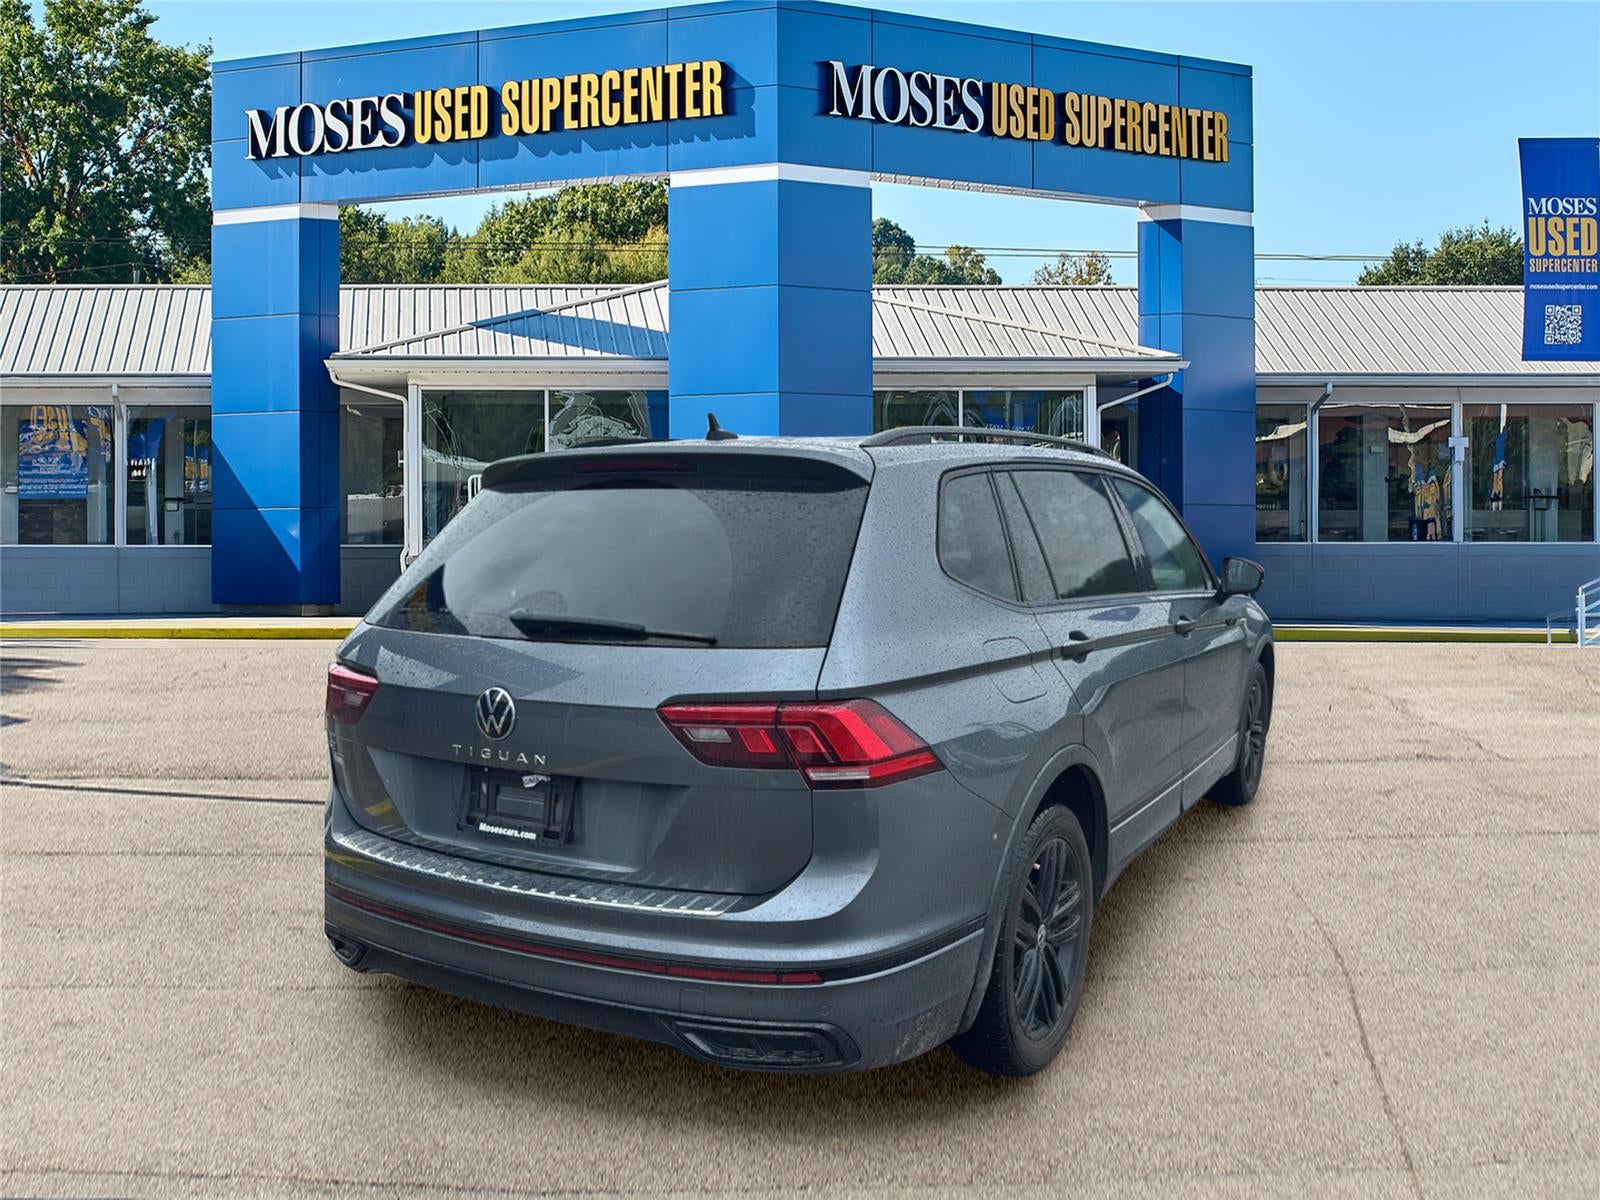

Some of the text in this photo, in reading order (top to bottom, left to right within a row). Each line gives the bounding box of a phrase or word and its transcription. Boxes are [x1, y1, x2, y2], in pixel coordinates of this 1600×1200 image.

[244, 60, 724, 160] MOSES USED SUPERCENTER
[828, 60, 1229, 162] MOSES USED SUPERCENTER
[1528, 197, 1597, 215] MOSES
[1528, 217, 1598, 256] USED
[1529, 258, 1598, 273] SUPERCENTER
[452, 744, 547, 765] TIGUAN
[478, 822, 537, 841] Mosescars.com
